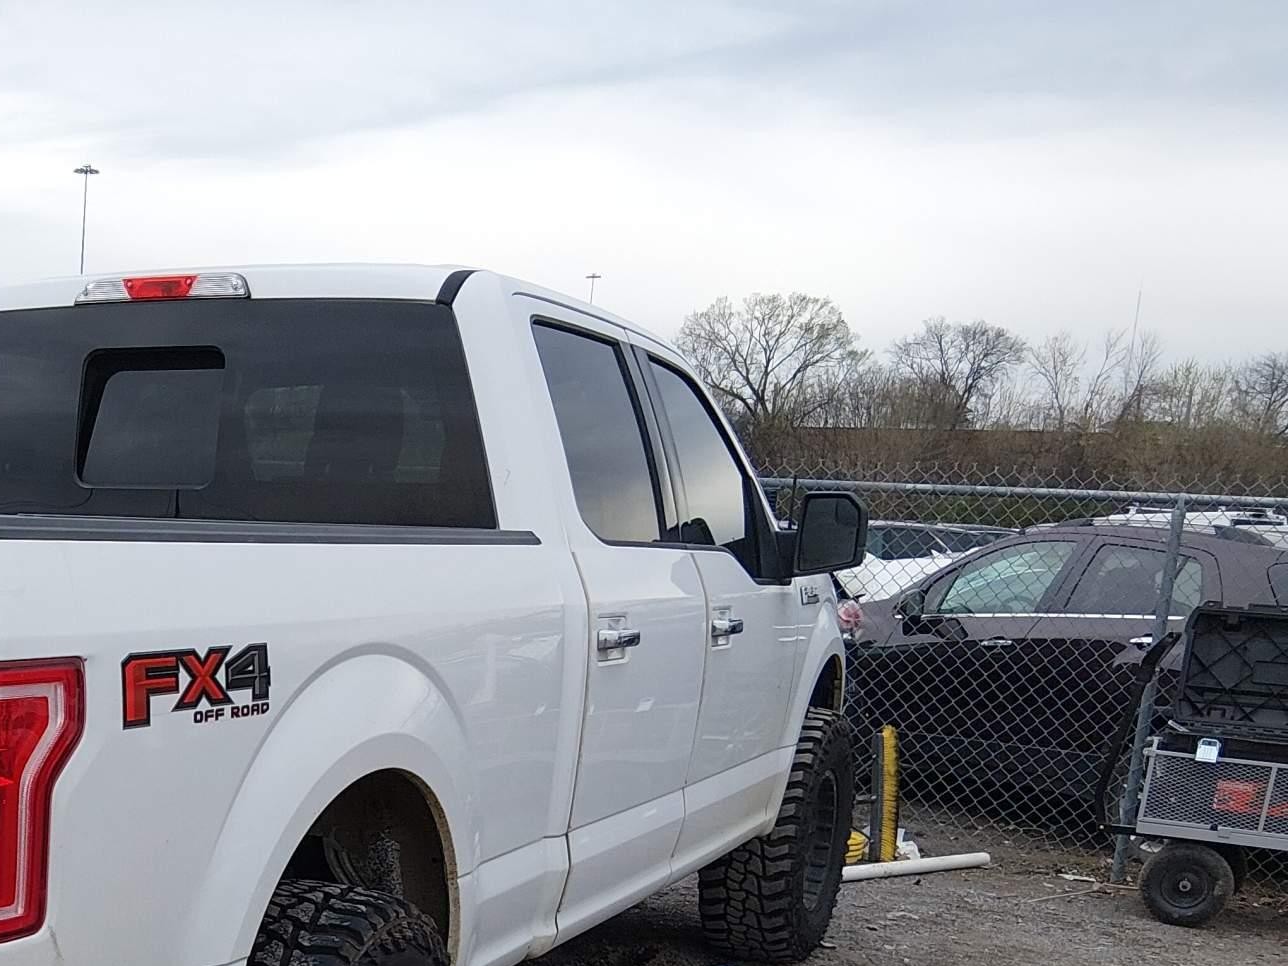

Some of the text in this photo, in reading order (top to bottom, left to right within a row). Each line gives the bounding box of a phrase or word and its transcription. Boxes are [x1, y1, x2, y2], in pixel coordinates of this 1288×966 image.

[120, 642, 271, 730] FX4
[193, 702, 270, 724] OFF ROAD
